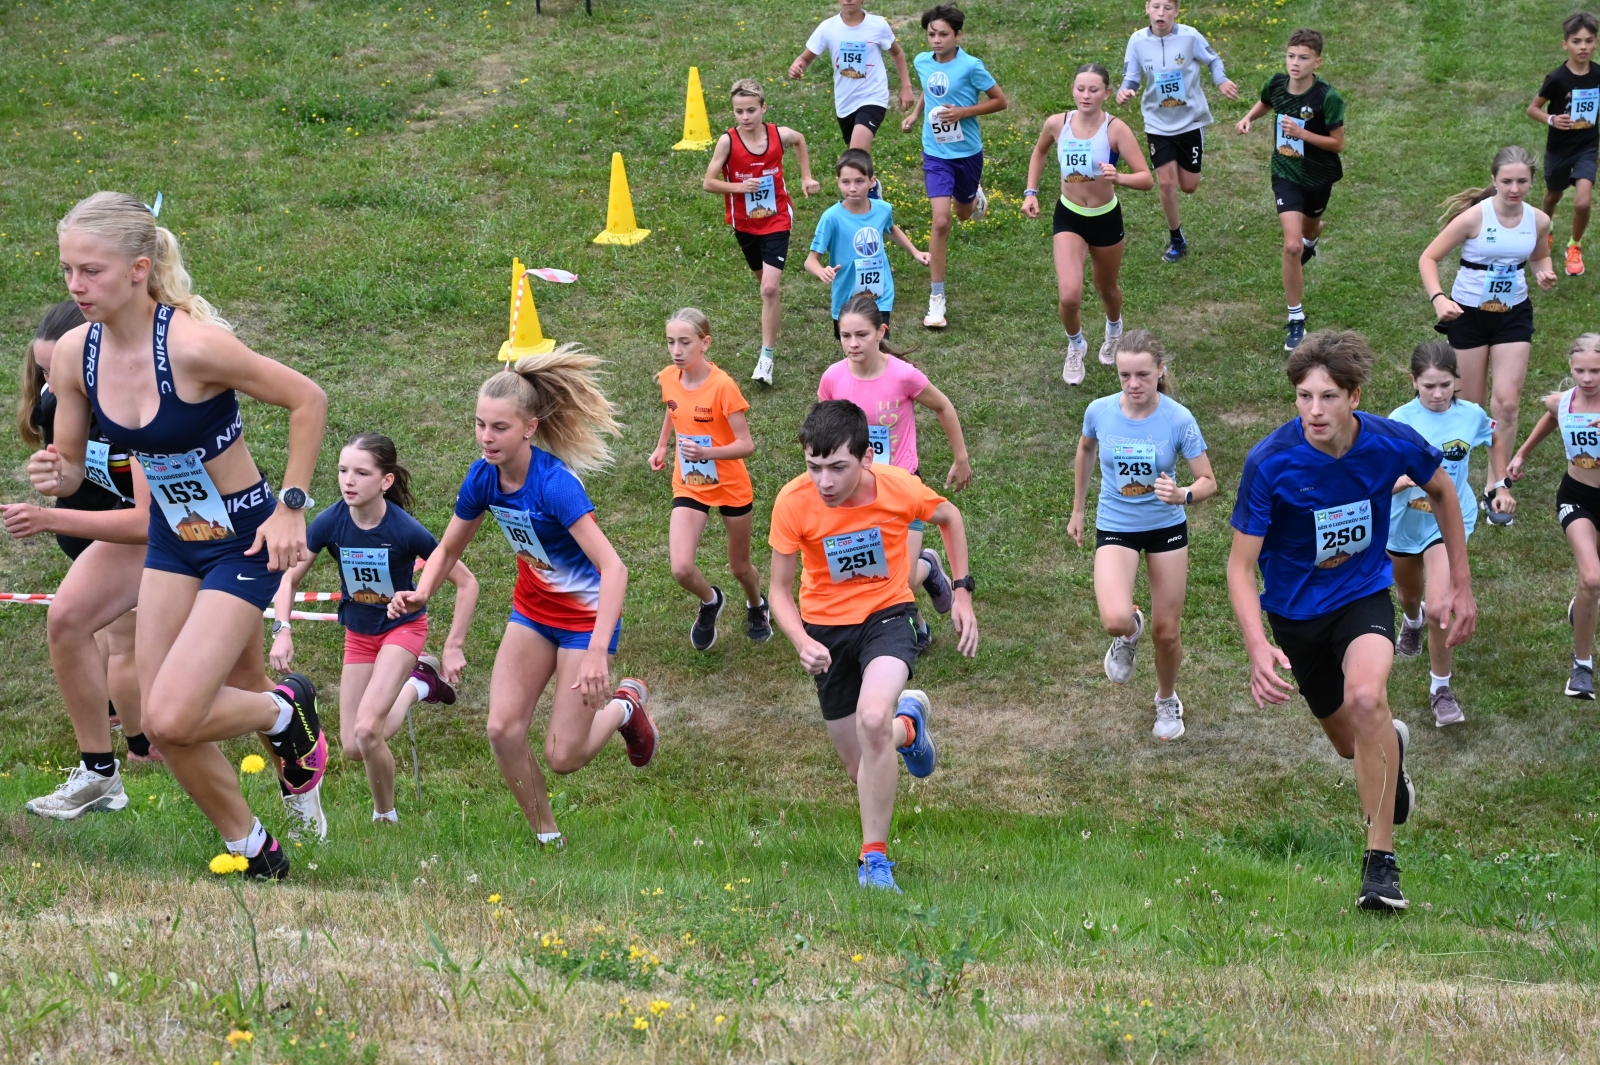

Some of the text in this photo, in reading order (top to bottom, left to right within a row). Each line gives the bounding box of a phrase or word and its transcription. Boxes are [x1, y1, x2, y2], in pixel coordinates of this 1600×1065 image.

[843, 53, 862, 63] 154
[1160, 82, 1180, 94] 155
[1576, 101, 1594, 113] 158
[1192, 146, 1199, 159] 5
[1066, 154, 1087, 166] 164
[750, 189, 770, 202] 157
[860, 272, 880, 285] 162
[1489, 281, 1512, 293] 152
[156, 322, 167, 371] NIKE
[86, 343, 96, 386] PRO
[1570, 431, 1599, 446] 165
[1118, 462, 1152, 476] 243
[158, 480, 208, 504] 153
[224, 488, 263, 514] IKE
[506, 526, 534, 546] 161
[1323, 525, 1366, 550] 250
[838, 550, 876, 572] 251
[352, 566, 381, 582] 151
